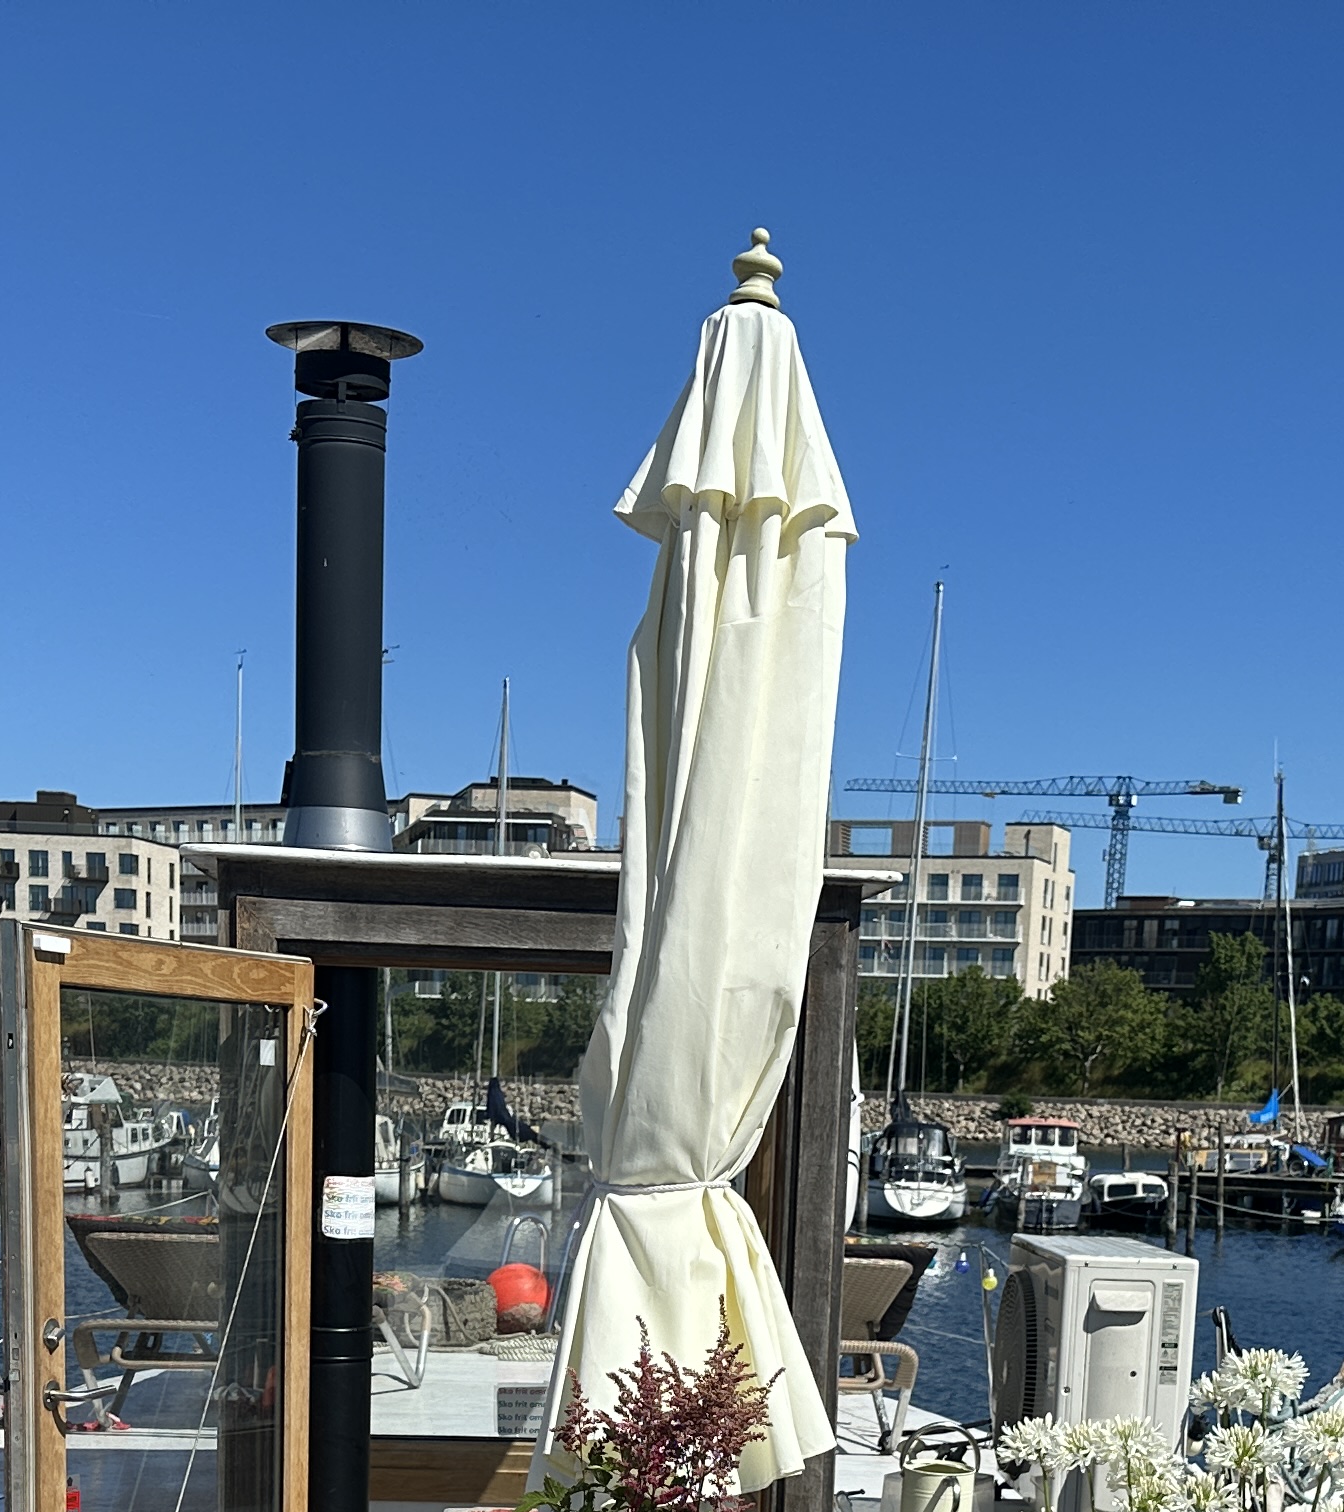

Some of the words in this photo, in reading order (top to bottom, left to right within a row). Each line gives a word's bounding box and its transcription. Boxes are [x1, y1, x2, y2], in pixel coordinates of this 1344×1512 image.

[324, 1209, 342, 1219] Sko
[323, 1225, 341, 1235] Sko
[498, 1387, 513, 1395] Sko
[515, 1387, 528, 1395] frit
[497, 1400, 513, 1409] Sko
[515, 1400, 528, 1408] frit
[497, 1413, 513, 1421] Sko
[514, 1413, 528, 1421] frit
[497, 1426, 512, 1434] Sko
[514, 1426, 527, 1434] frit
